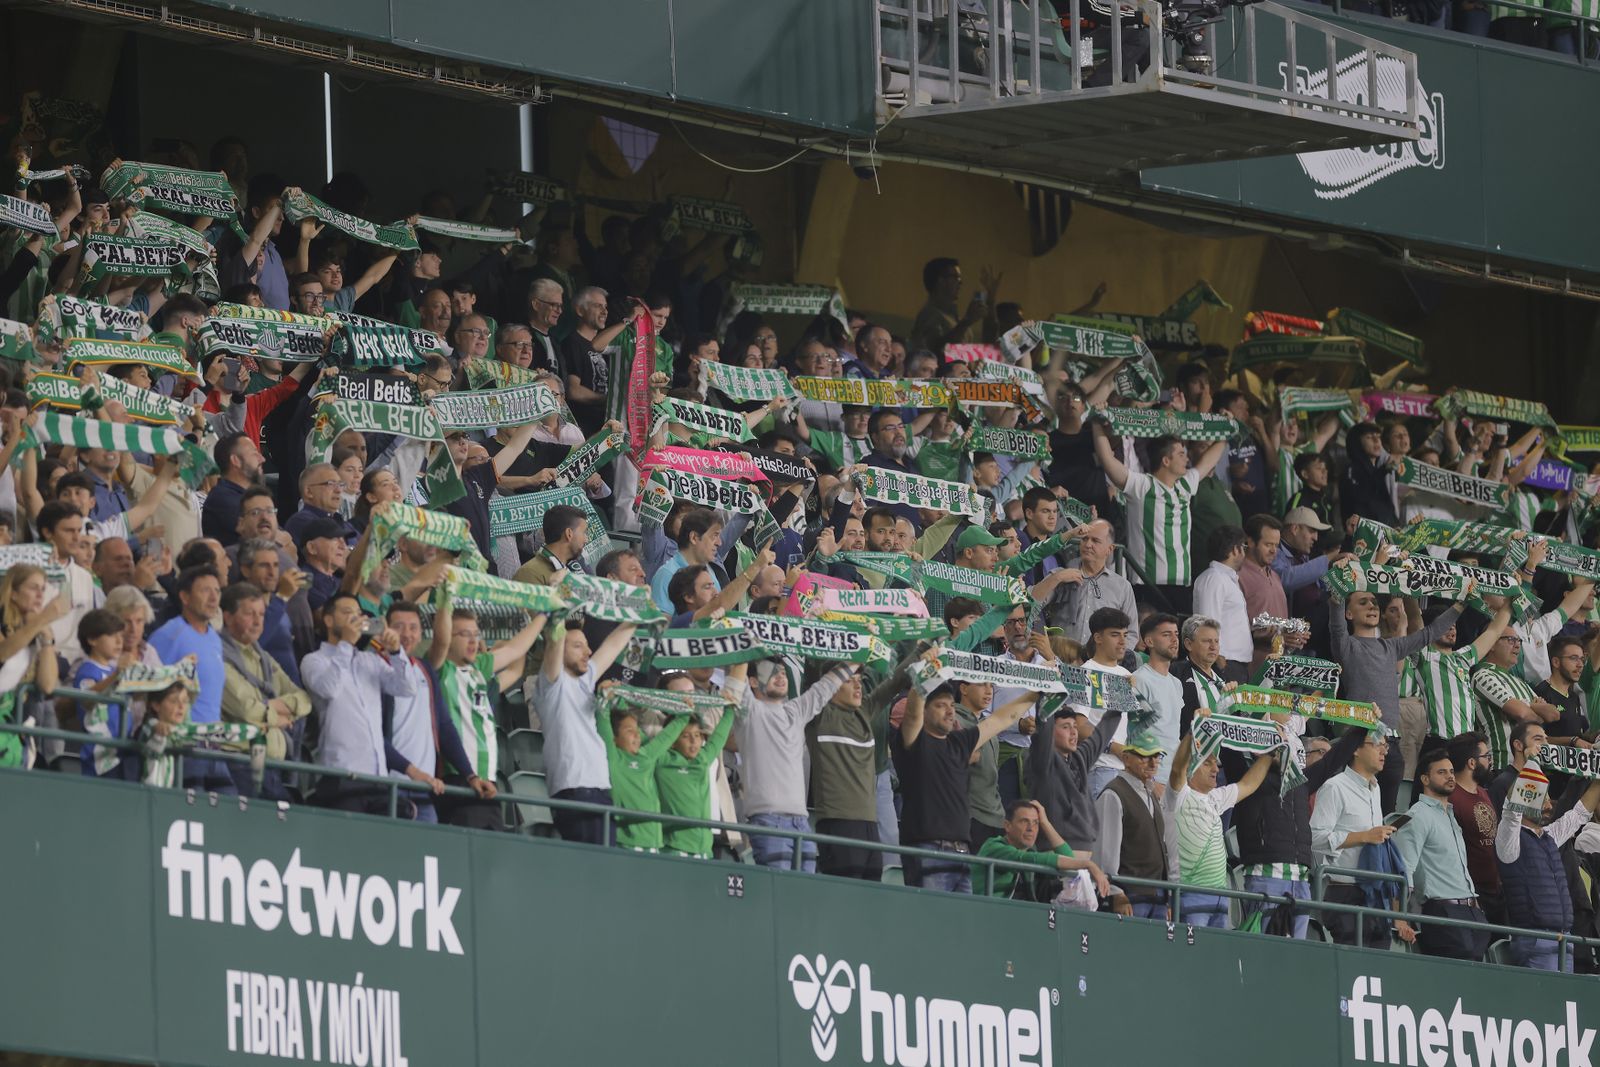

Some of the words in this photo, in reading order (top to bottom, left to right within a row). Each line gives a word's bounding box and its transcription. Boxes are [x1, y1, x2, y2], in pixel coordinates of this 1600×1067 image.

[150, 185, 188, 206] REAL
[191, 193, 235, 213] BETIS
[91, 242, 131, 264] EAL
[133, 244, 182, 266] BETIS
[62, 300, 92, 317] SOY
[211, 321, 253, 347] Betis
[287, 330, 324, 354] Betis
[338, 375, 369, 401] Real
[373, 378, 412, 405] Betis
[867, 379, 896, 406] SUR
[335, 401, 383, 429] REAL
[388, 403, 436, 439] BETIS
[671, 403, 705, 427] REAL
[705, 411, 742, 436] BETIS
[666, 471, 753, 509] RealBetis
[1419, 464, 1492, 502] RealBetis
[491, 510, 507, 524] AL
[511, 505, 545, 520] BETIS
[1367, 570, 1398, 584] SOY
[1411, 557, 1452, 575] REAL
[1461, 566, 1511, 588] BETIS
[838, 590, 869, 608] REAL
[874, 590, 909, 608] BETIS
[655, 639, 680, 657] AL
[688, 633, 751, 657] BETIS
[742, 620, 795, 644] REAL
[801, 627, 860, 652] BETIS
[161, 820, 464, 955] finetwork
[226, 969, 304, 1059] FIBRA
[305, 979, 324, 1062] Y
[327, 971, 409, 1067] MÓVIL
[859, 963, 1053, 1067] hummel
[1347, 975, 1597, 1067] finetwork
